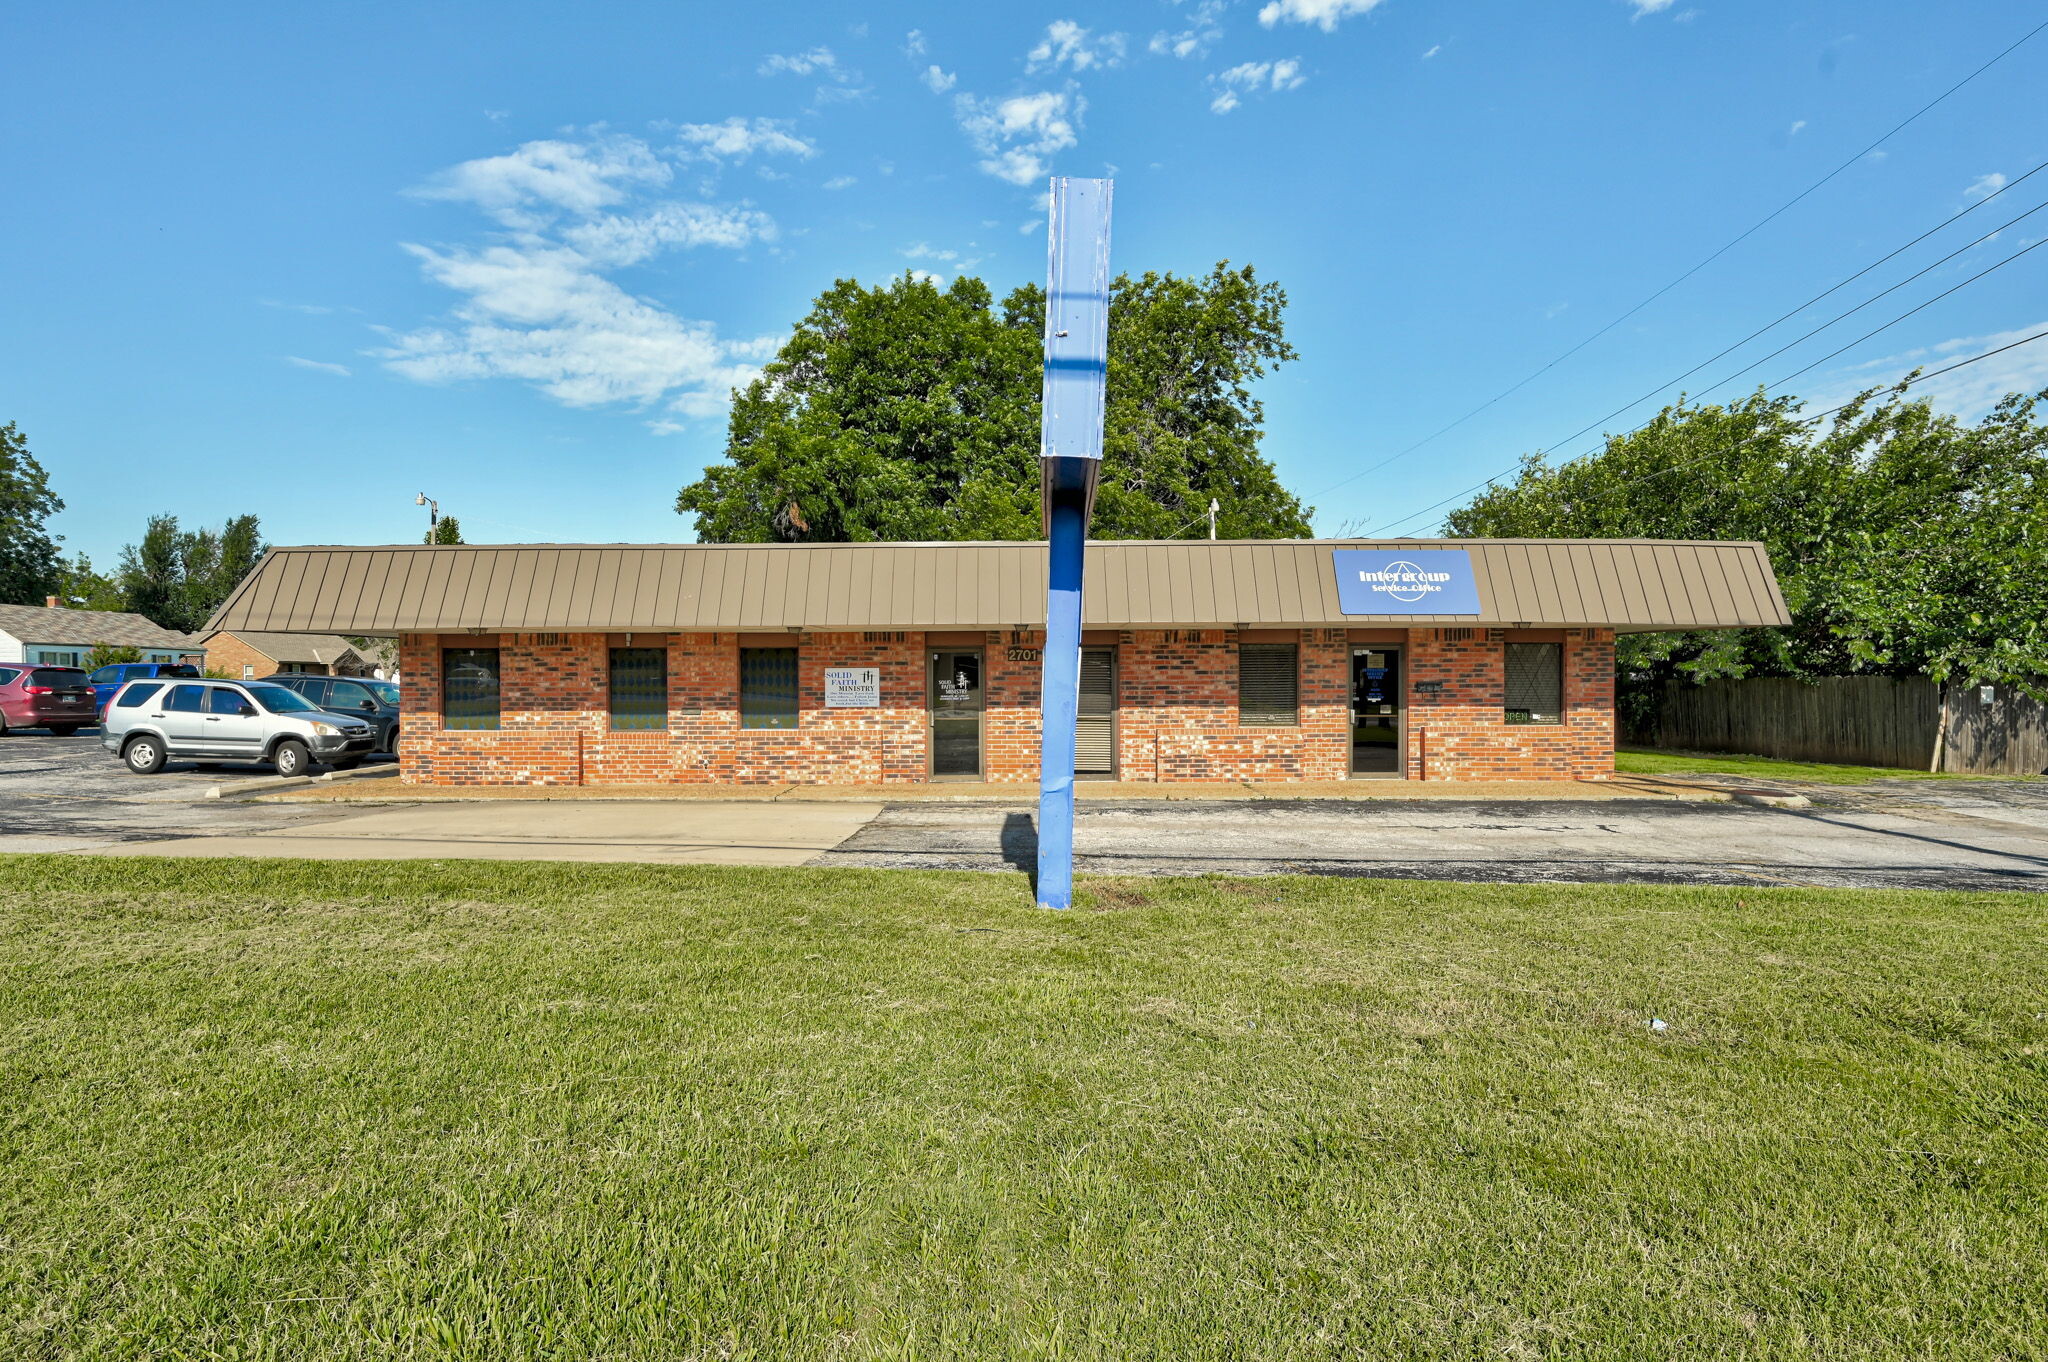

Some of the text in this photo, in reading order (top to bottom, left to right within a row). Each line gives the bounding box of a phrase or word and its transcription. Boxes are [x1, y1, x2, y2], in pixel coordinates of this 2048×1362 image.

[1359, 571, 1450, 582] Intergroup
[1009, 650, 1036, 660] 2701
[1504, 712, 1528, 721] OPEN
